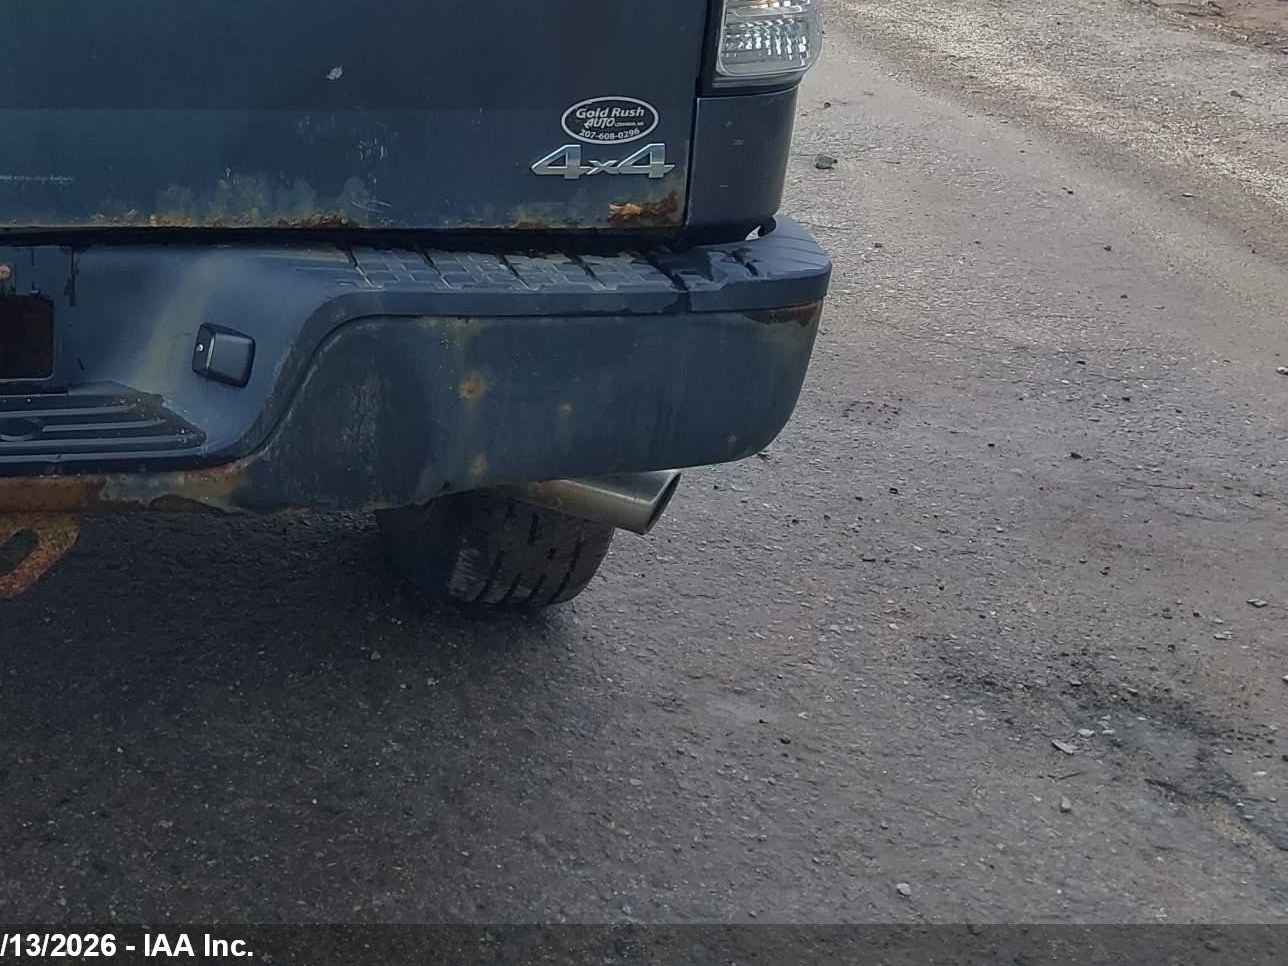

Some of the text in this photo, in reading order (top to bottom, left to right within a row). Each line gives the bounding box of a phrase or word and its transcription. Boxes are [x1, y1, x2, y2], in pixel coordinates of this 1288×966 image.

[576, 106, 645, 119] Gold Rush
[584, 117, 615, 129] AUTO
[531, 143, 676, 179] 4x4
